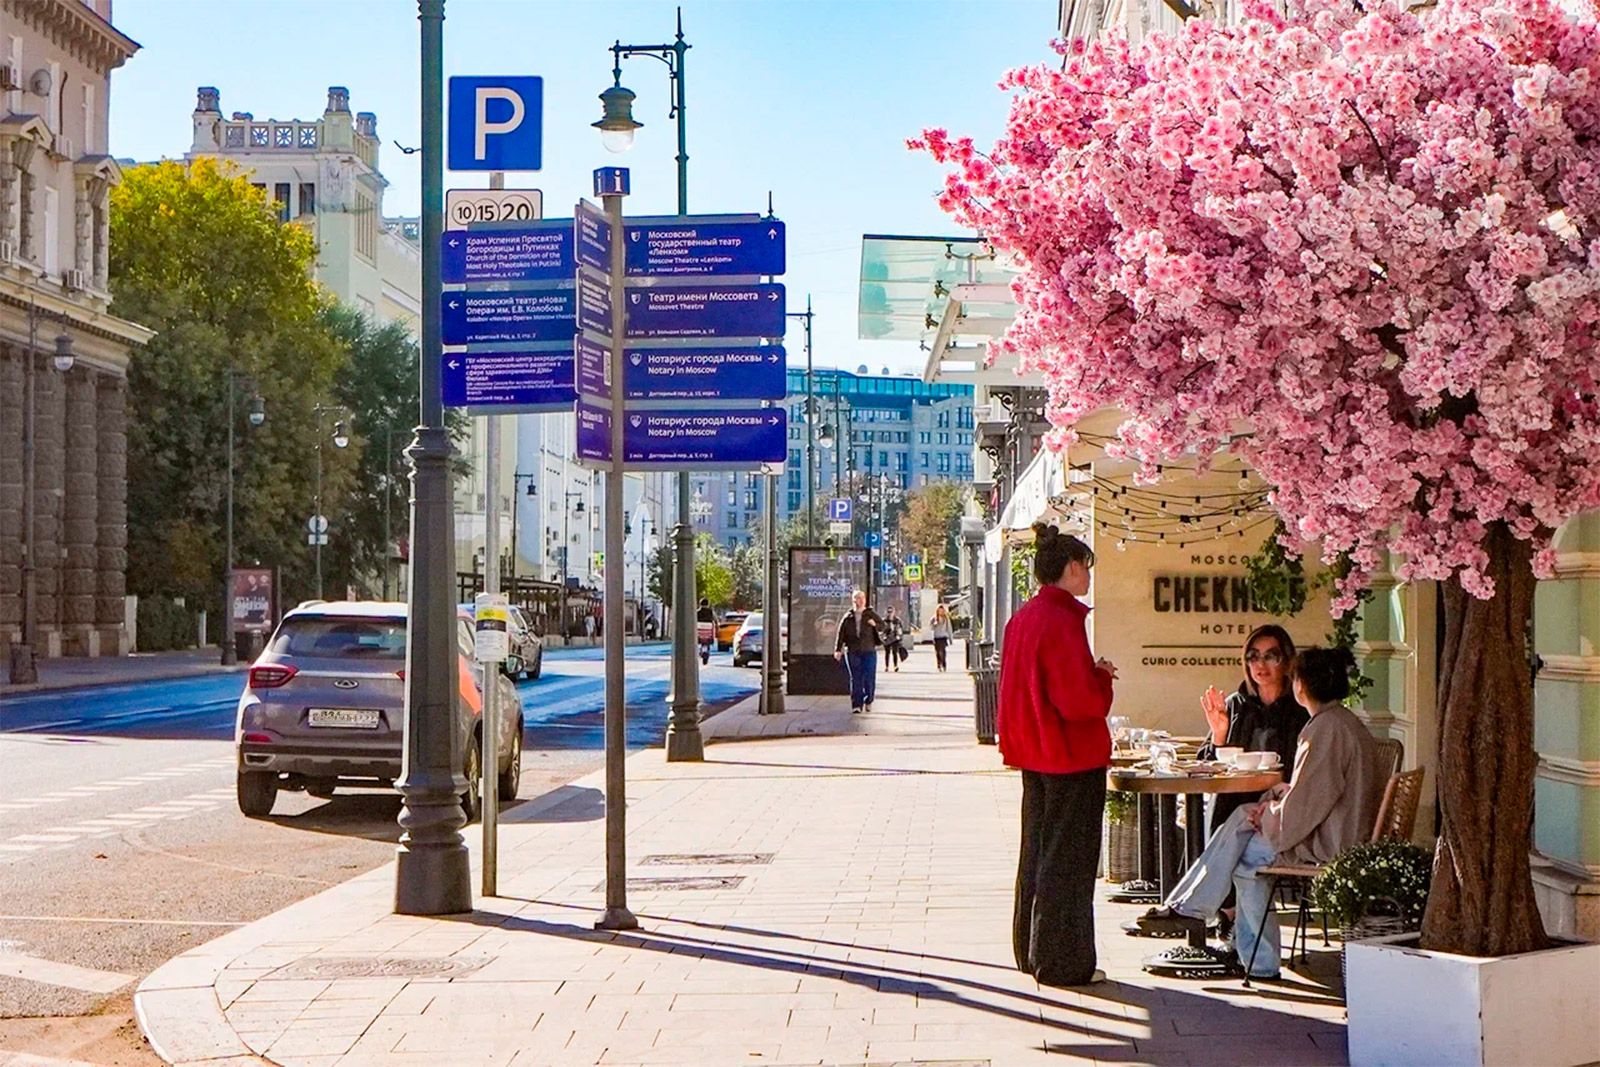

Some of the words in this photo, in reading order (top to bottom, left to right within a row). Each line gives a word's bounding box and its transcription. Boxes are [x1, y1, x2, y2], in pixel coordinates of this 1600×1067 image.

[475, 88, 525, 160] P
[458, 206, 472, 220] 10
[478, 205, 494, 220] 15
[502, 204, 530, 220] 20
[466, 237, 487, 246] Храм
[488, 236, 520, 245] Успения
[522, 233, 563, 244] Пресвятой
[648, 230, 697, 239] Московский
[648, 239, 718, 248] государственный
[719, 239, 741, 247] театр
[466, 245, 515, 254] Богородицы
[522, 244, 559, 252] Путинках
[483, 262, 497, 270] Holy
[466, 297, 514, 306] Московский
[515, 298, 537, 306] театр
[648, 293, 676, 303] Театр
[709, 292, 758, 301] Моссовета
[466, 307, 495, 315] Опера»
[526, 304, 563, 312] Колобова
[648, 355, 691, 365] Нотариус
[693, 355, 725, 364] города
[726, 353, 762, 362] Москвы
[648, 367, 675, 376] Notary
[648, 417, 691, 427] Нотариус
[693, 417, 725, 426] города
[726, 416, 762, 425] Москвы
[648, 429, 675, 438] Notary
[836, 502, 848, 518] P
[1191, 555, 1264, 565] MOSCO
[1142, 657, 1177, 666] CURIO
